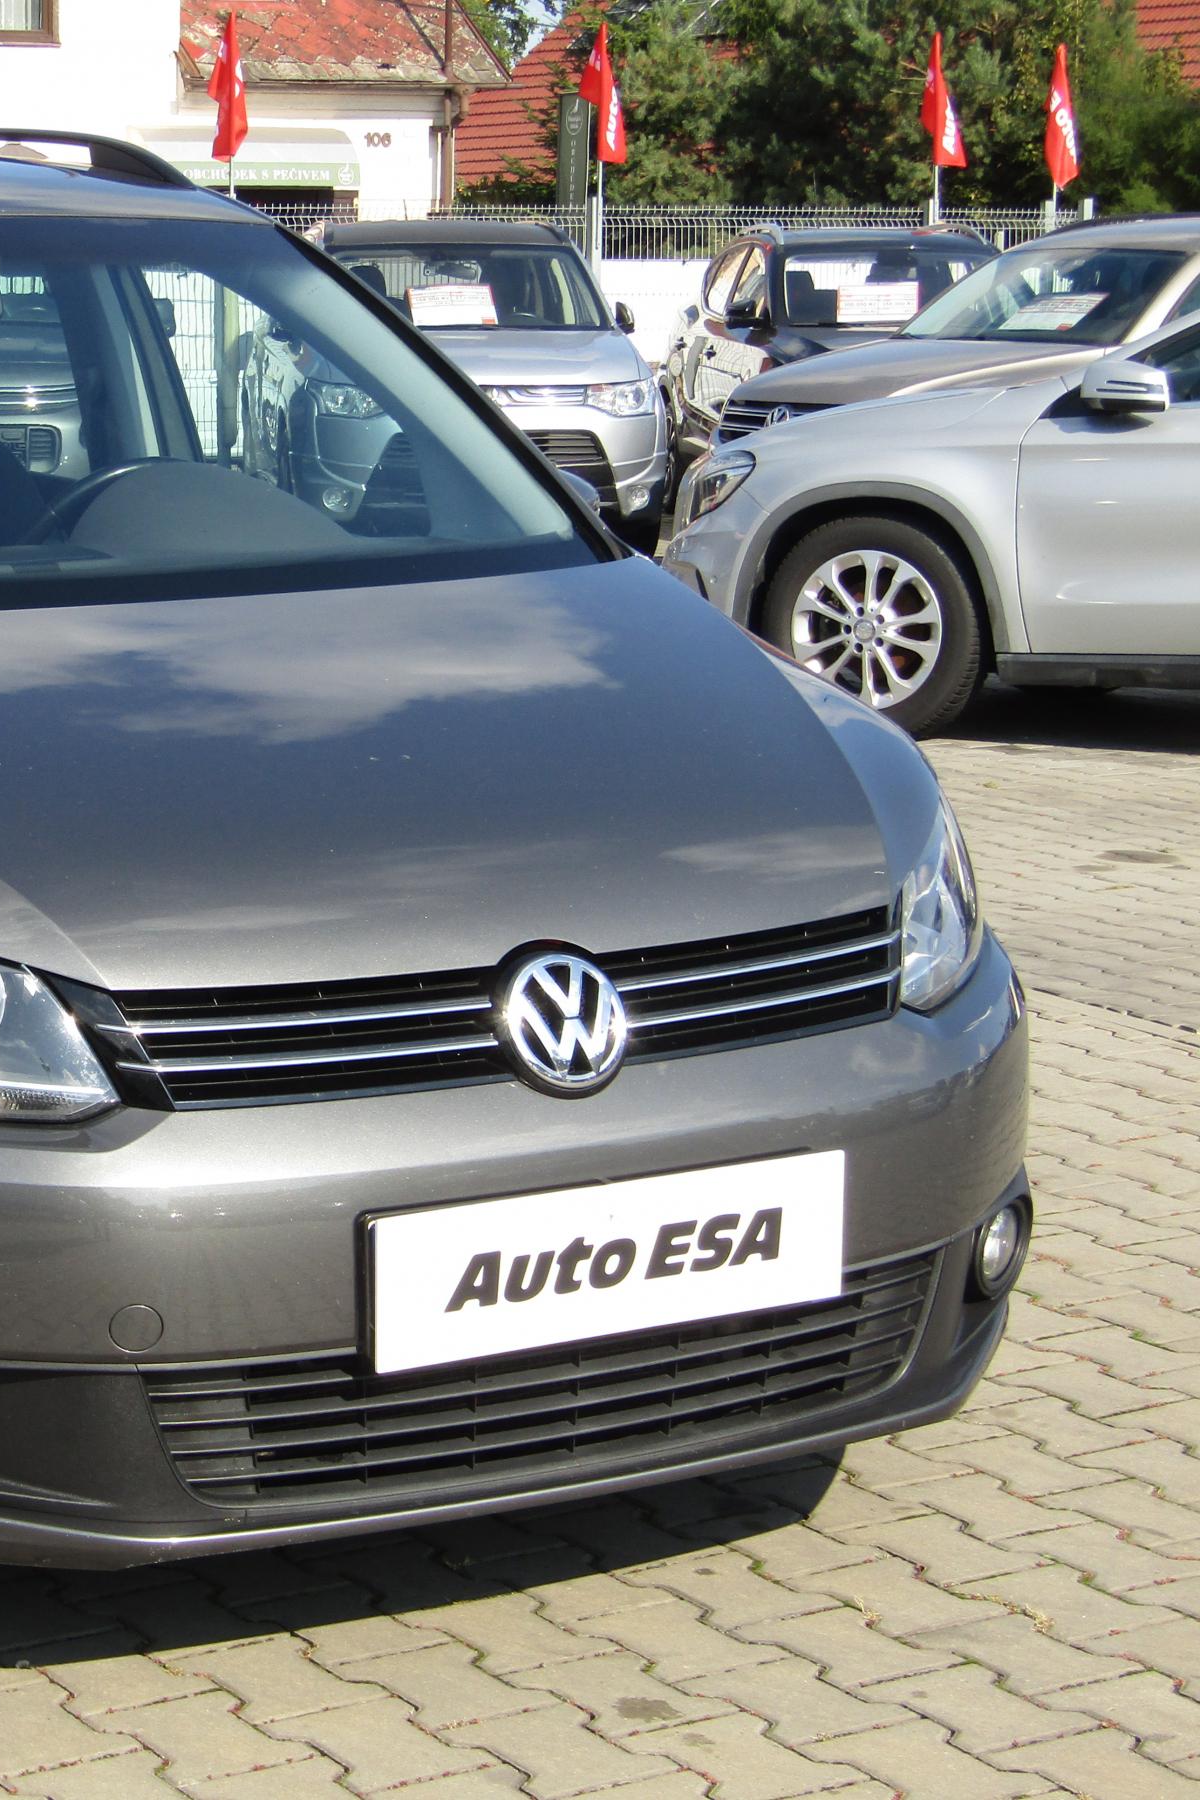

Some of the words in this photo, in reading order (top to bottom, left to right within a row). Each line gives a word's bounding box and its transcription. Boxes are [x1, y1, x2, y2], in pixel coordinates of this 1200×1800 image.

[364, 132, 391, 148] 106
[261, 169, 270, 181] S
[273, 167, 331, 181] PEČIVEM
[444, 1237, 636, 1313] Auto
[644, 1207, 783, 1280] ESA
